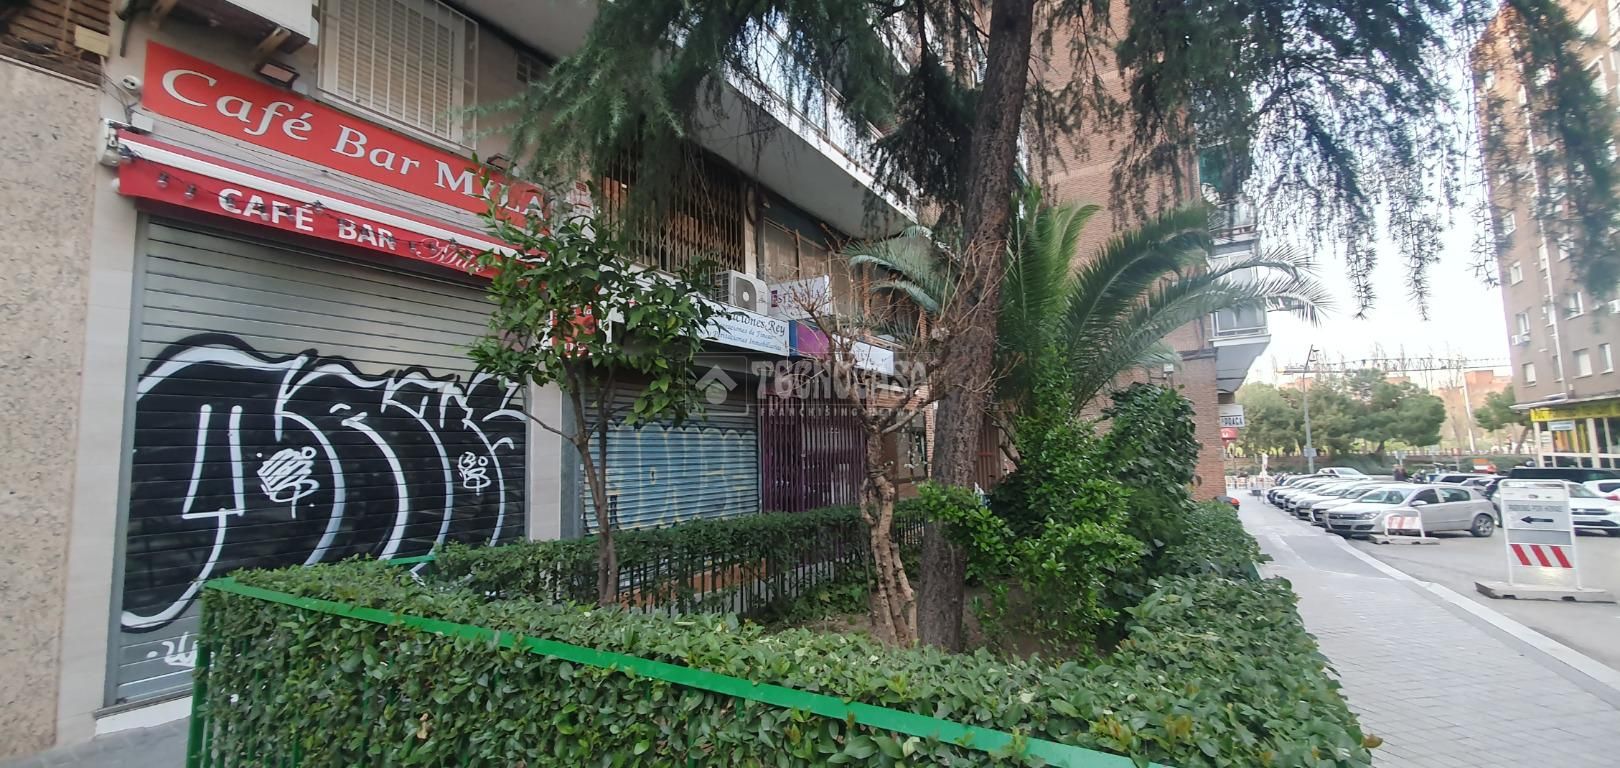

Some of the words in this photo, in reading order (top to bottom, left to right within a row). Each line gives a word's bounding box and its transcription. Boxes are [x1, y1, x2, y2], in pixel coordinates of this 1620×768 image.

[161, 68, 313, 142] Café
[331, 124, 421, 176] Bar
[217, 187, 314, 233] CAFÉ
[337, 218, 397, 252] BAR
